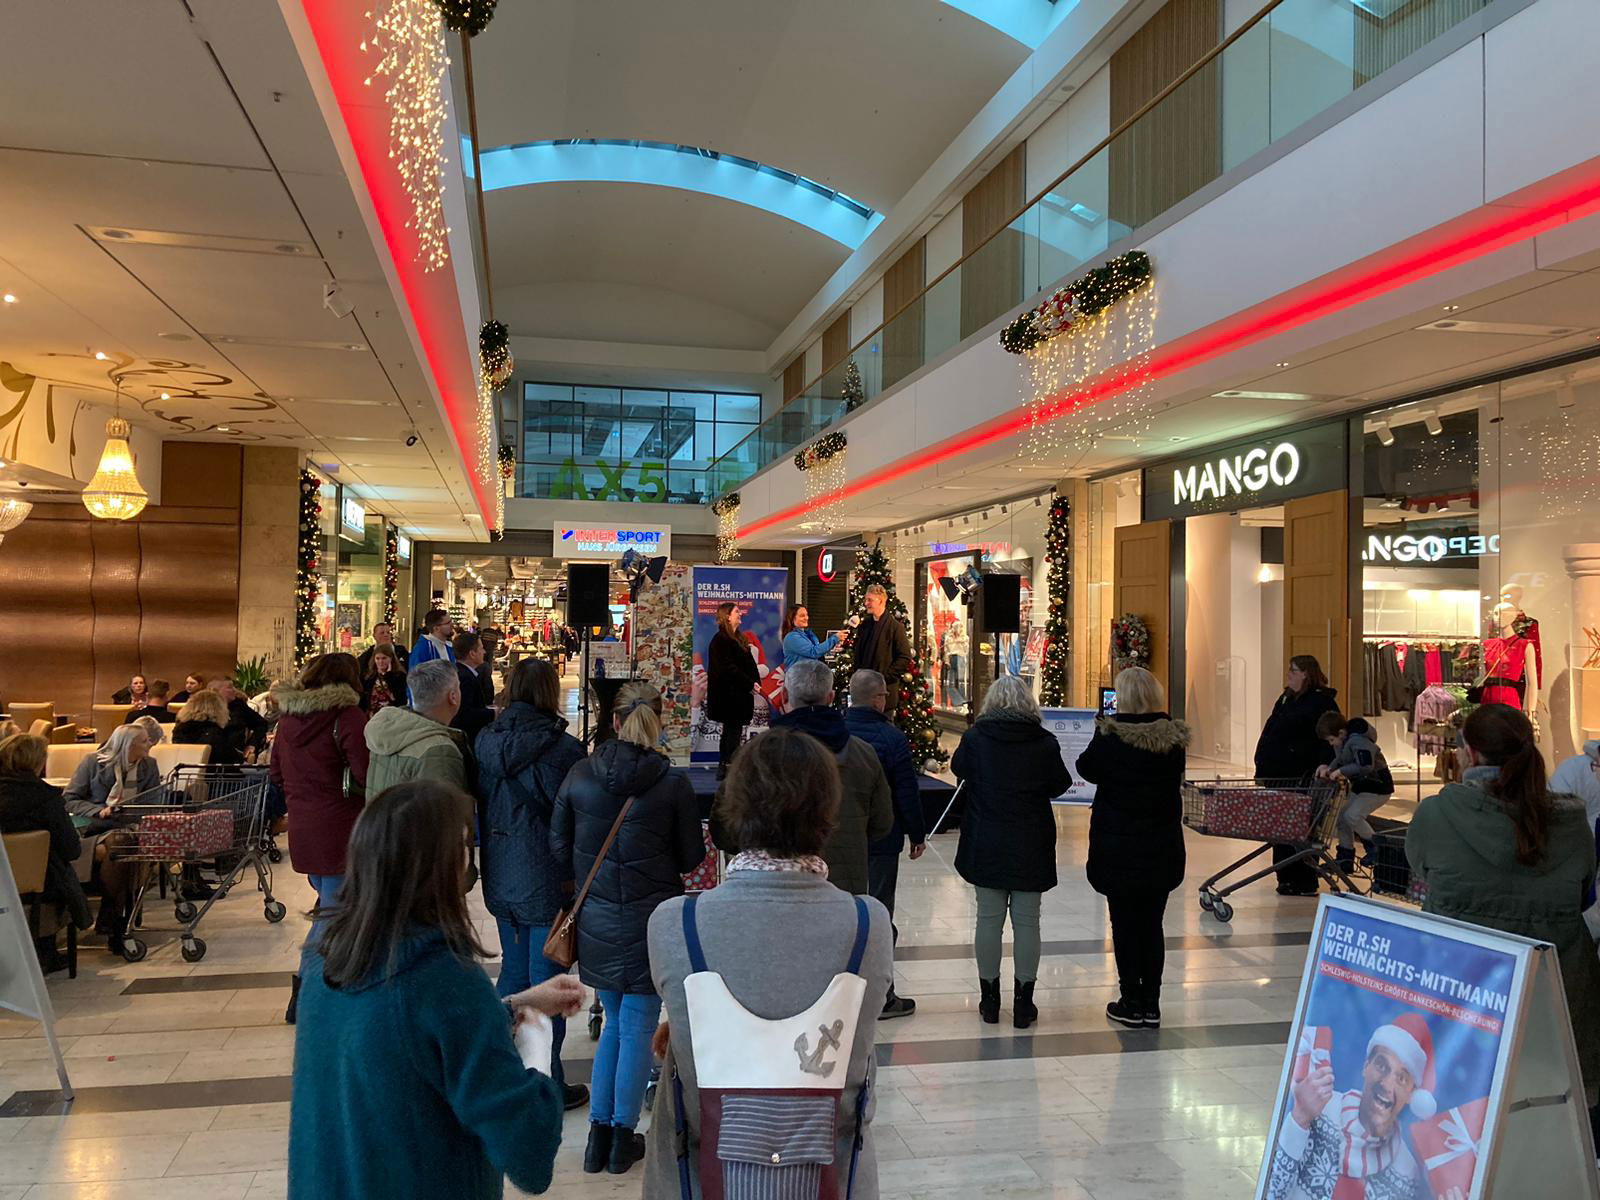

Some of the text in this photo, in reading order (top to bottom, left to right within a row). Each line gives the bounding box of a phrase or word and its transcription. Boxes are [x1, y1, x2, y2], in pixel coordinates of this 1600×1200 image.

[1174, 442, 1299, 505] MANGO
[575, 529, 661, 542] INTERSPORT
[1362, 535, 1444, 562] NGO
[697, 583, 731, 591] DER R.SH
[697, 591, 784, 600] WEIHNACHTS-MITTMANN
[1327, 922, 1391, 955] DER R.SH
[1323, 938, 1508, 1013] WEIHNACHTS-MITTMANN
